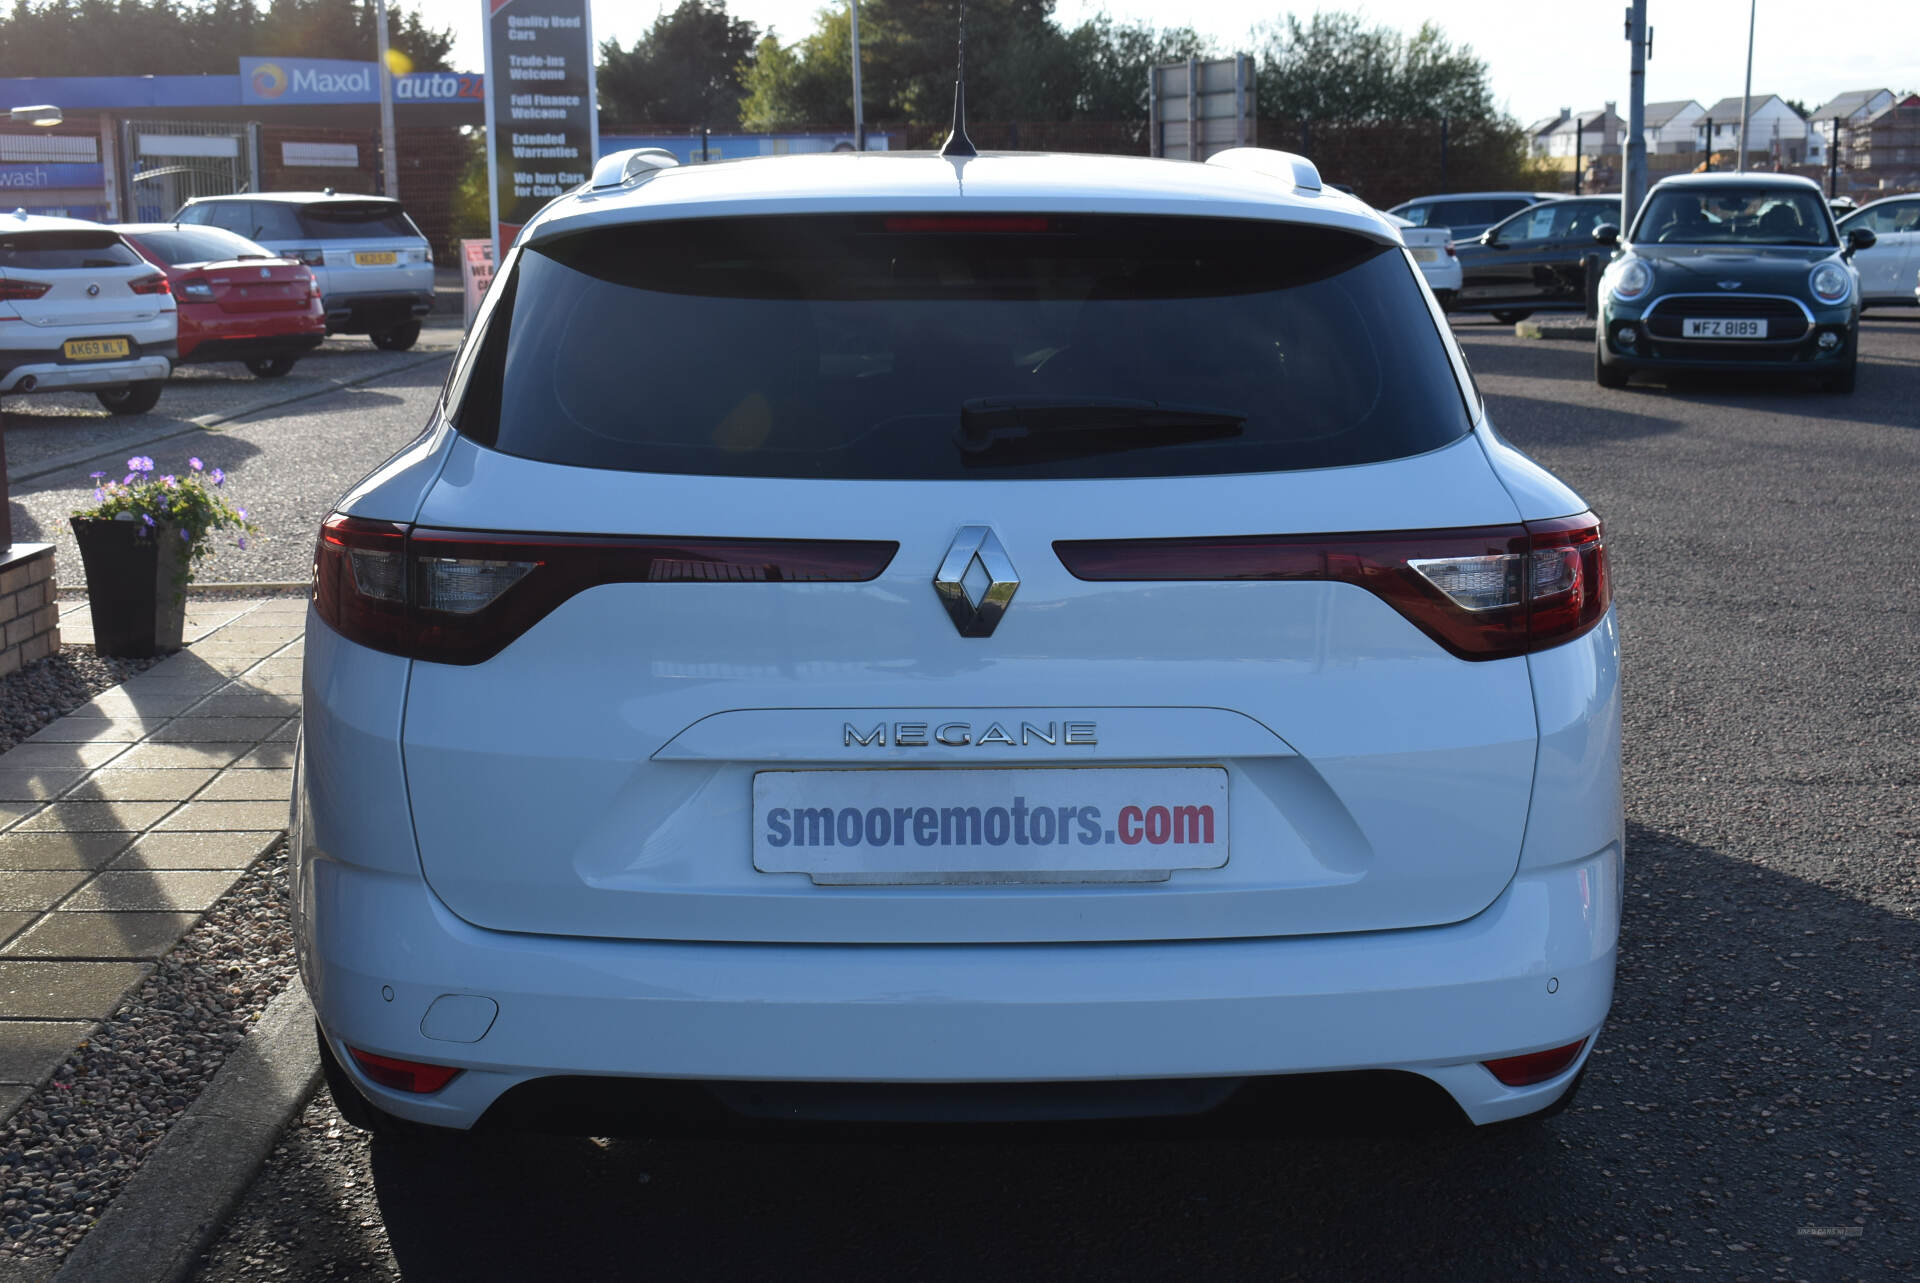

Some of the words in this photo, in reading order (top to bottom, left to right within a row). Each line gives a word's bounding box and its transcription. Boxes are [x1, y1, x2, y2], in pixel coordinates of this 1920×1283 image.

[508, 15, 549, 28] Quality
[551, 16, 580, 28] Used
[508, 28, 536, 40] Cars
[293, 67, 371, 93] Maxol
[510, 68, 565, 80] Welcome
[511, 94, 532, 106] Full
[534, 94, 580, 106] Finance
[511, 107, 566, 119] Welcome
[512, 133, 565, 145] Extended
[512, 146, 578, 158] Warranties
[514, 172, 532, 184] We
[535, 172, 557, 184] buy
[514, 185, 531, 197] for
[1692, 322, 1721, 335] WFZ
[1725, 322, 1758, 335] 8189
[71, 344, 99, 355] AK69
[842, 721, 1098, 747] MEGANE
[766, 797, 1215, 848] smooremotors.com
